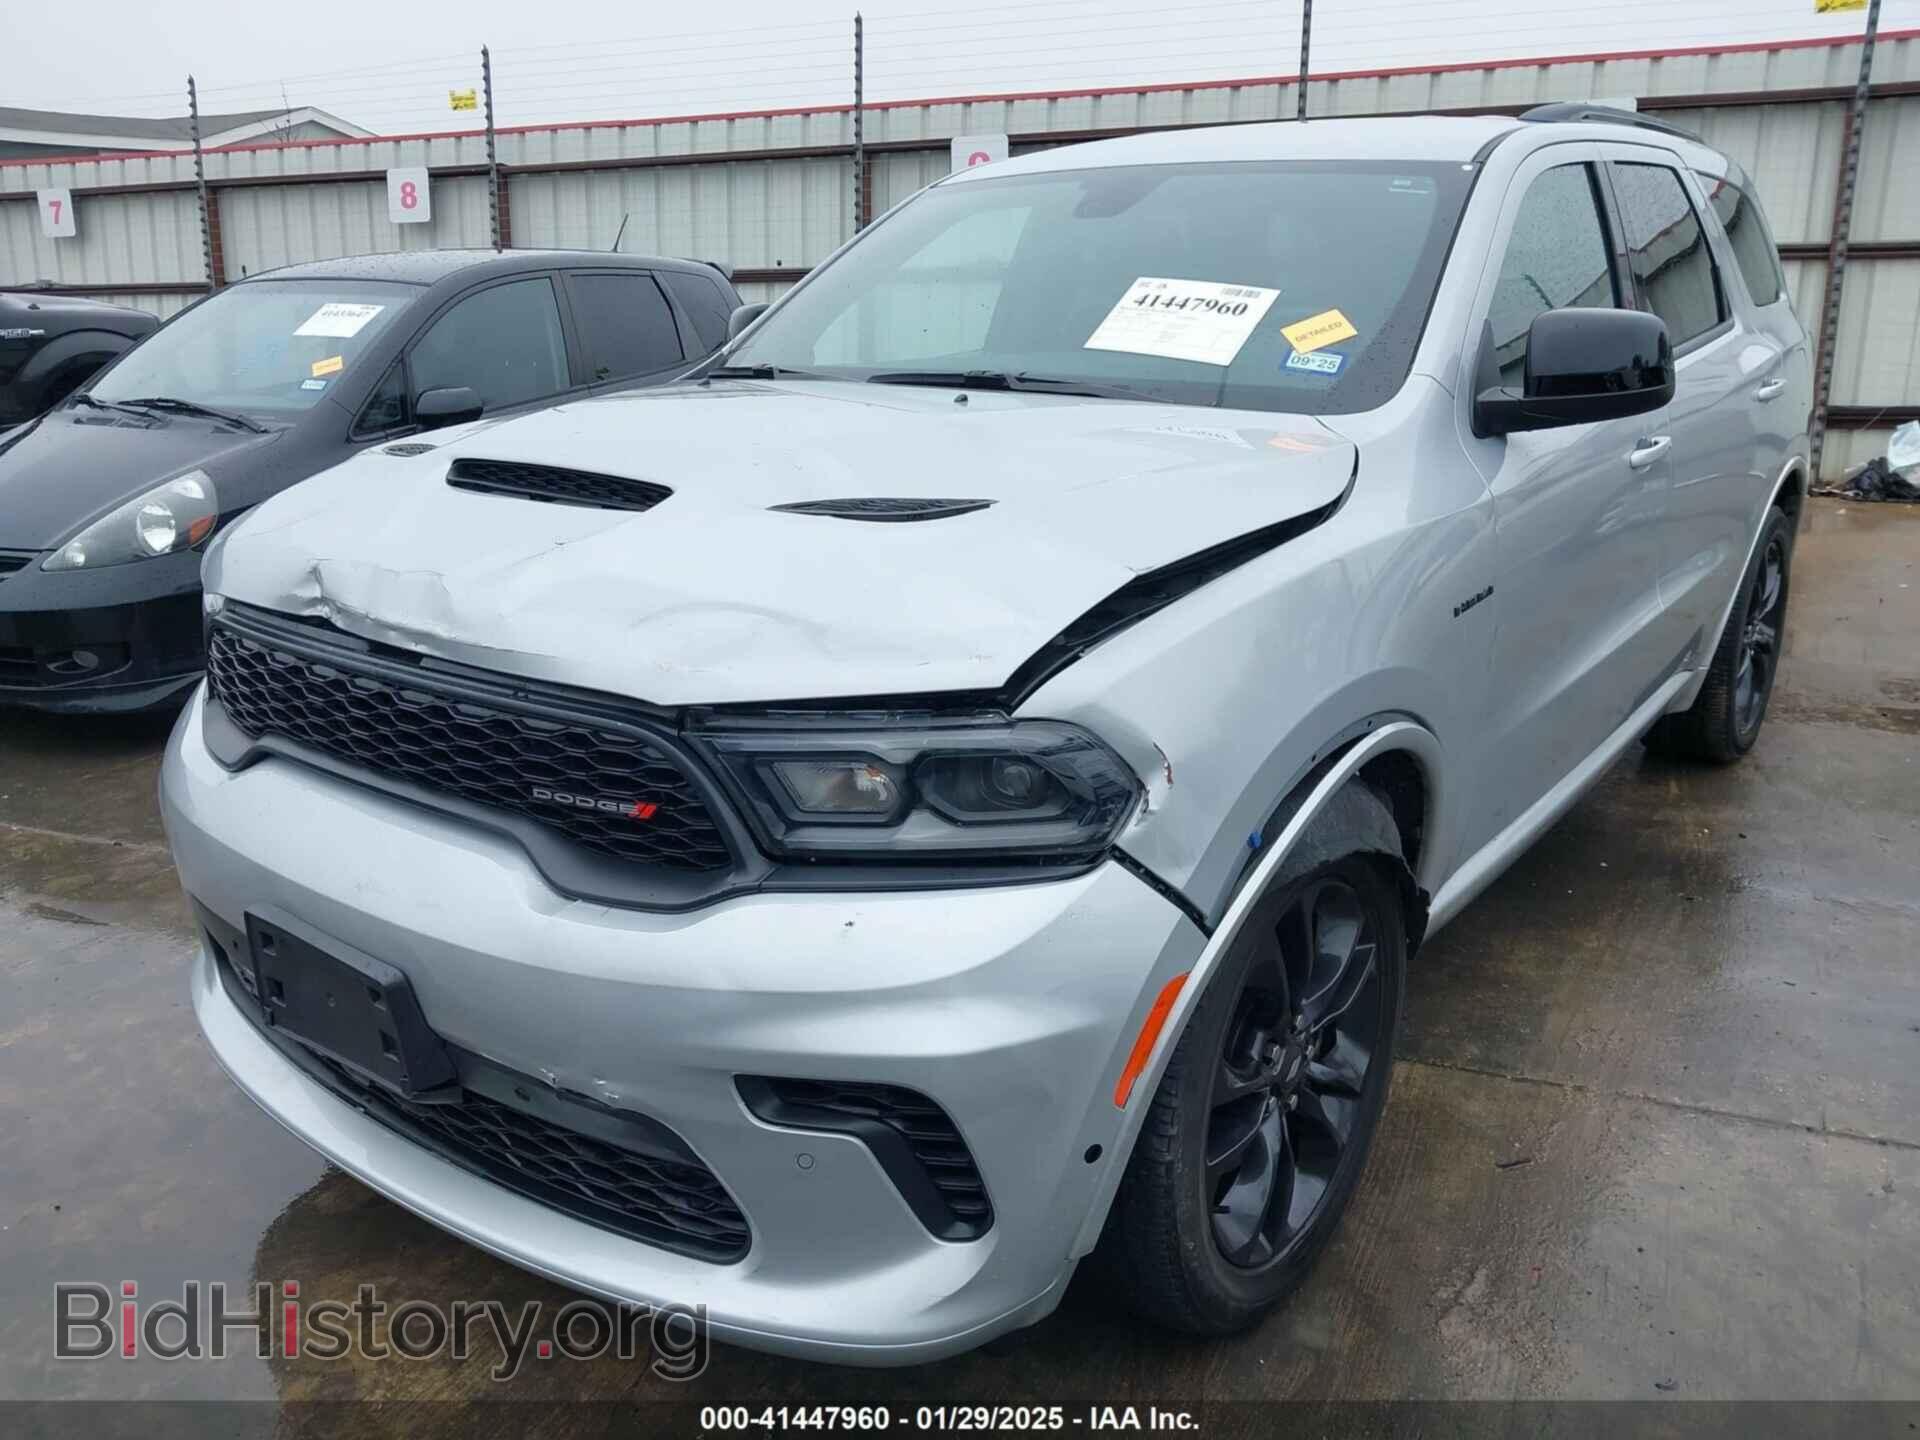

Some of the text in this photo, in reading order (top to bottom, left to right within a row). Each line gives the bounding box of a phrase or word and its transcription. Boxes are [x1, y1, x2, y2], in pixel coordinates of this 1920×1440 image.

[400, 181, 417, 209] 8
[49, 200, 62, 224] 7
[1132, 293, 1249, 317] 41447960
[1295, 321, 1342, 342] DETAILED
[1291, 355, 1337, 370] 09 25
[532, 788, 638, 814] DODGE
